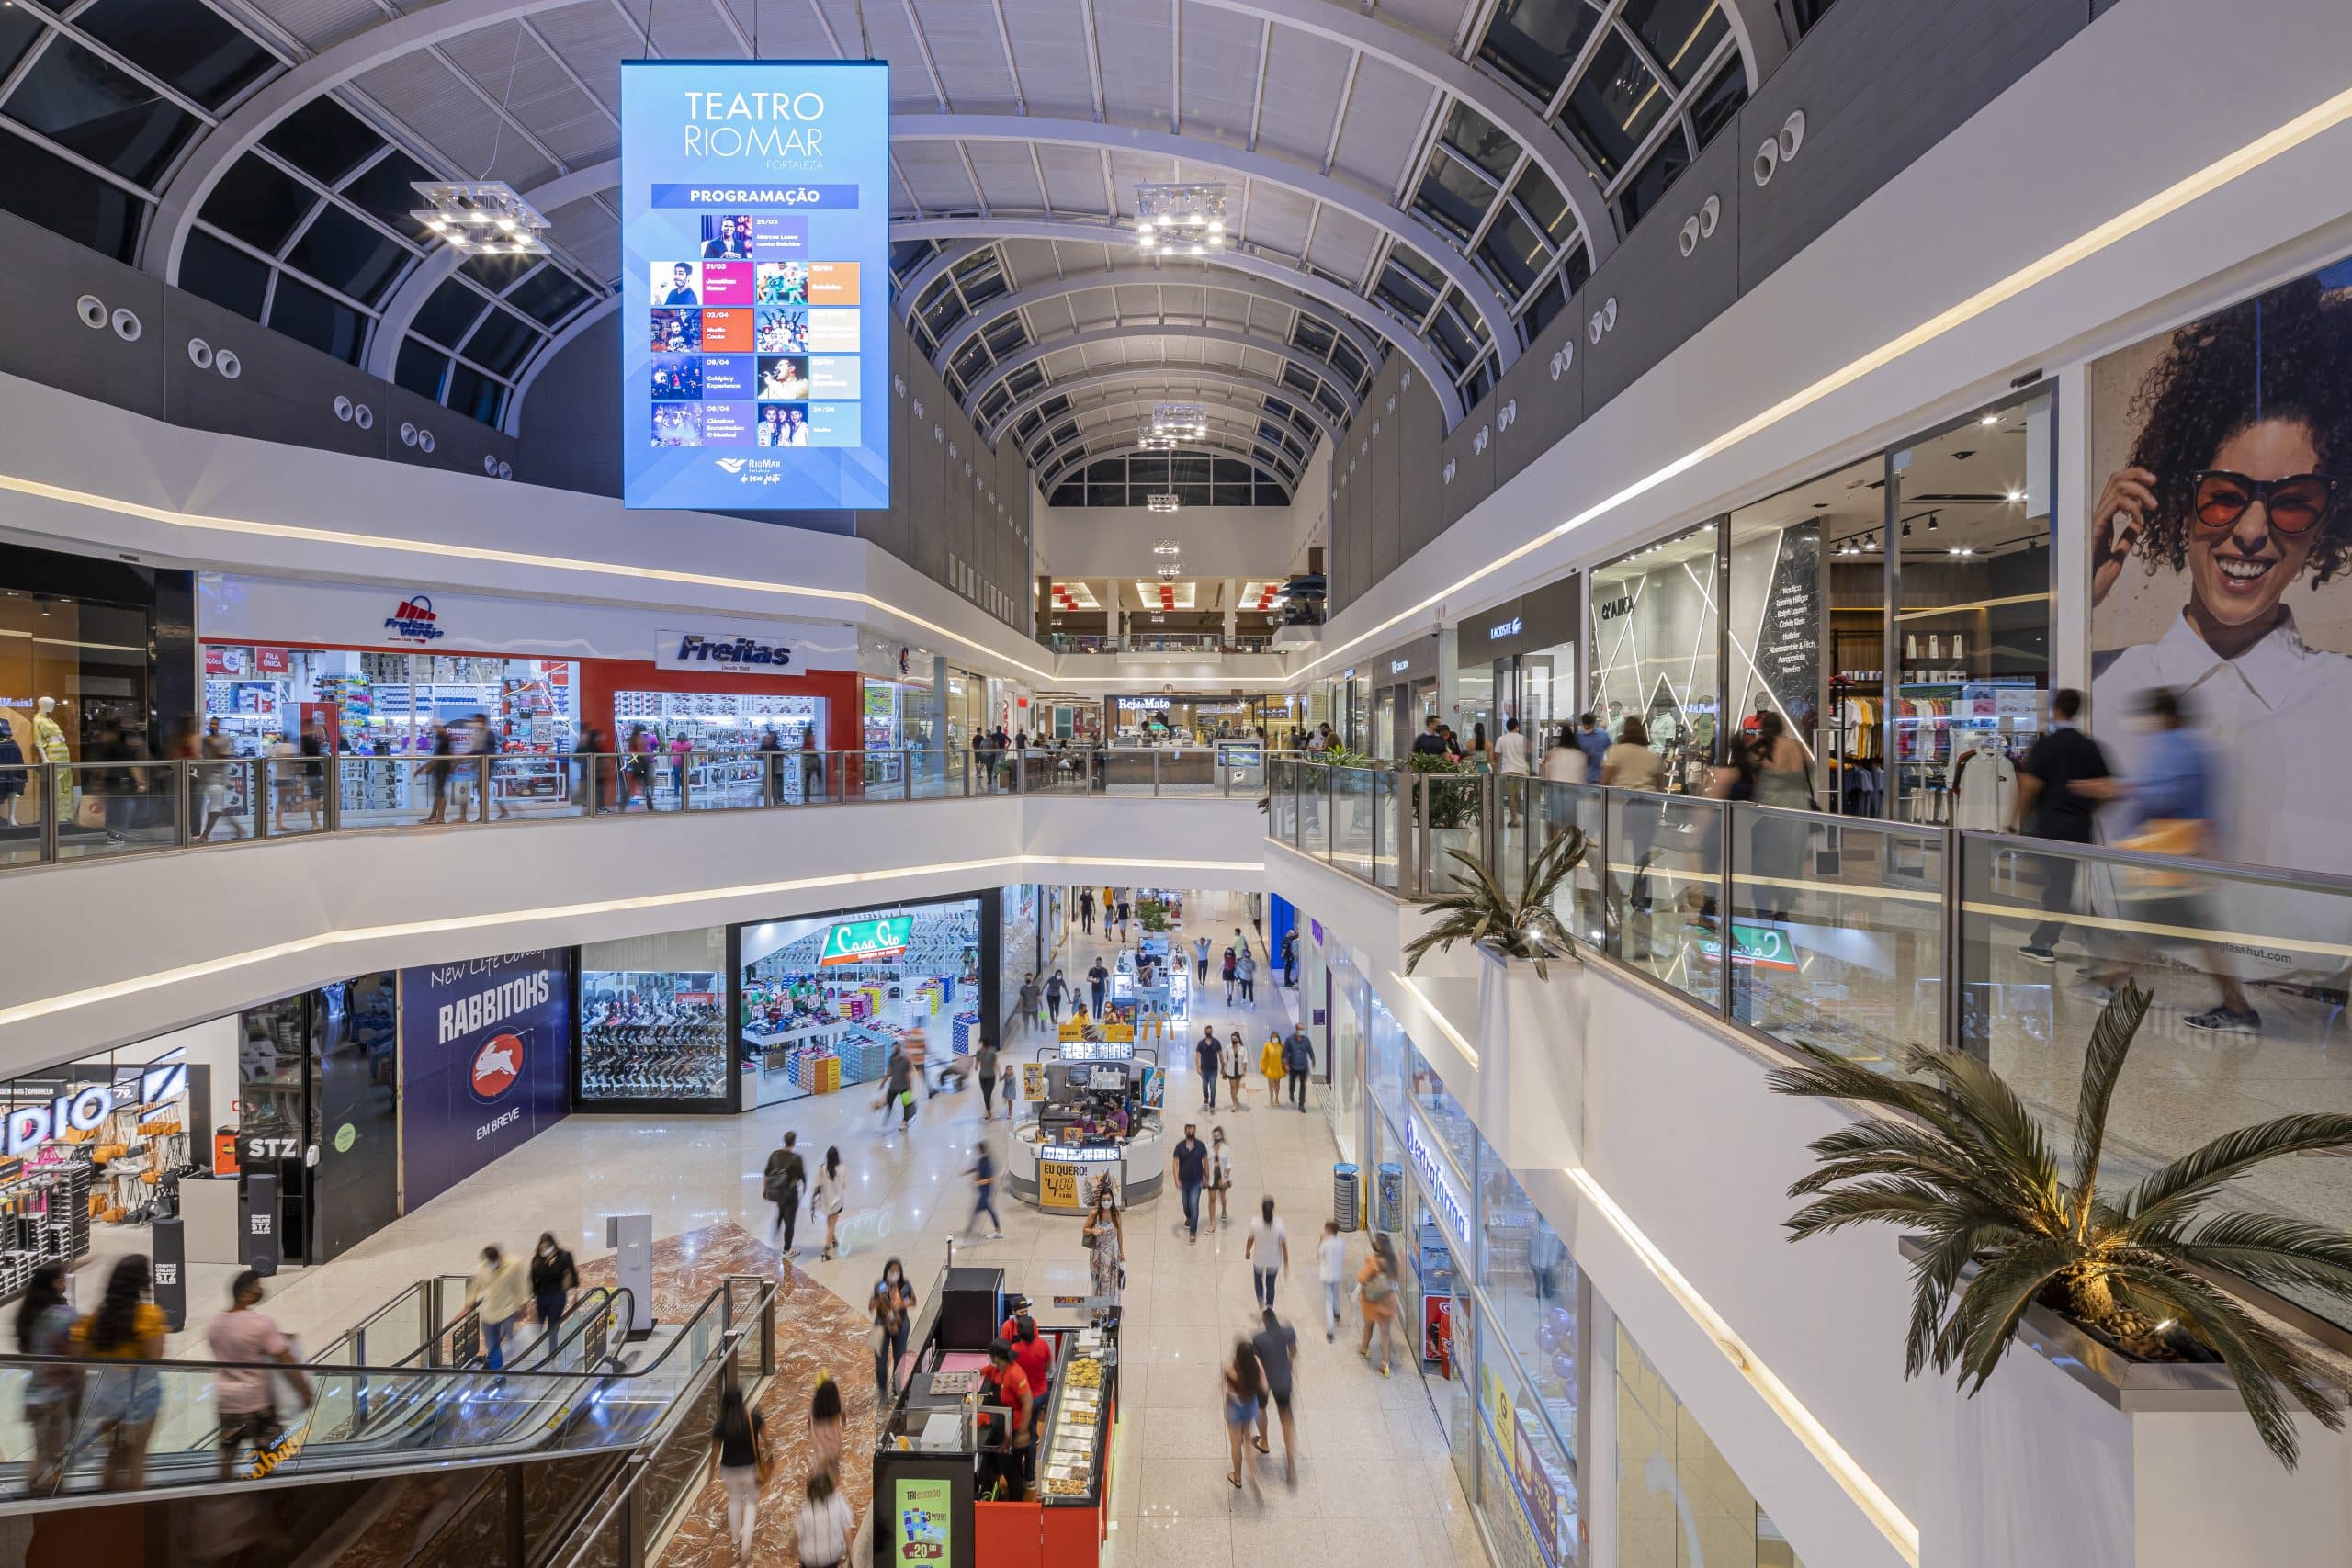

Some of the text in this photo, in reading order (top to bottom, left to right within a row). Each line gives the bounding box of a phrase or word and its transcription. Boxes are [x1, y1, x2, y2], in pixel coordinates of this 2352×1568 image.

[685, 92, 824, 121] TEATRO
[684, 125, 823, 157] RIOMAR
[766, 160, 824, 170] FORTALEZA
[691, 188, 820, 205] PROGRAMAÇÃO
[1782, 584, 1802, 595] Nautica
[1776, 597, 1793, 607] Tommy
[1777, 606, 1808, 618] Ralph Lauren
[384, 618, 435, 630] Freitas
[1490, 622, 1513, 640] LACOSTE
[1779, 616, 1806, 628] Calvin Klein
[266, 652, 279, 660] FILA
[677, 635, 791, 666] Freitas
[837, 926, 877, 953] Casa
[430, 964, 466, 989] New
[439, 970, 549, 1045] RABBITOHS
[0, 1086, 112, 1156] DIO
[476, 1107, 521, 1141] EM BREVE
[249, 1138, 298, 1157] STZ
[1044, 1163, 1088, 1177] EU QUERO!
[1415, 1139, 1470, 1243] extrafarma
[155, 1272, 177, 1280] STZ
